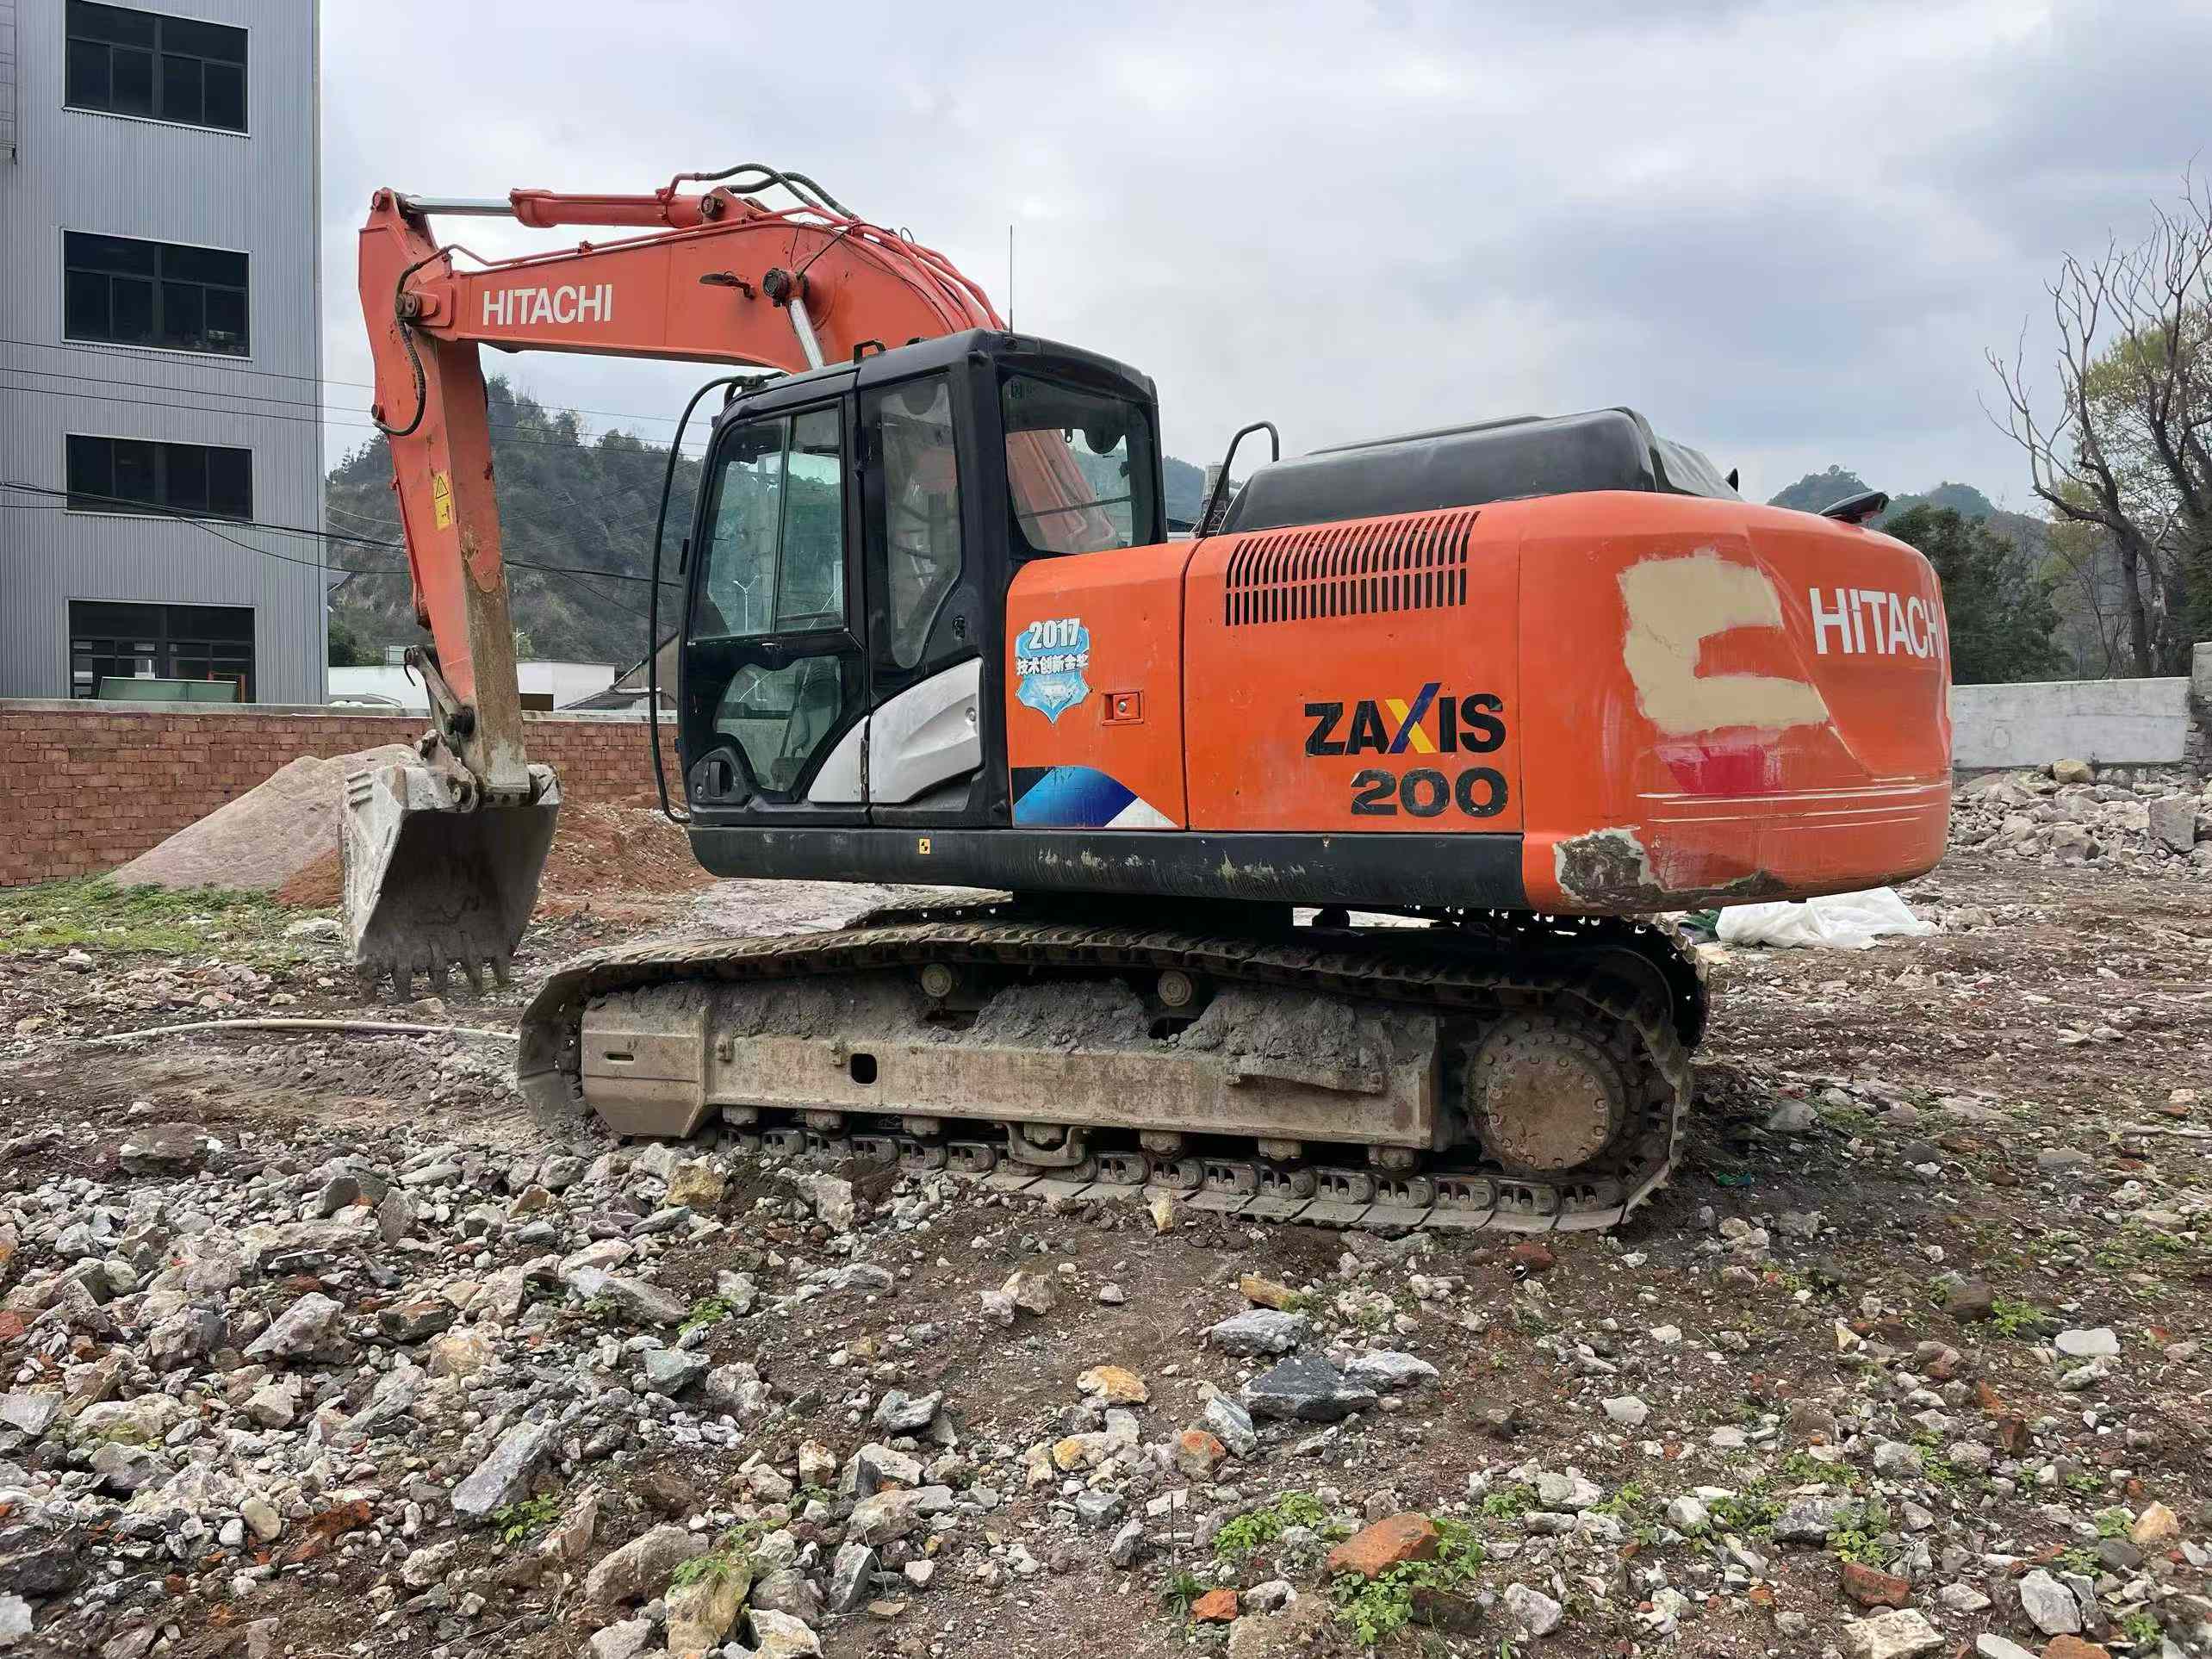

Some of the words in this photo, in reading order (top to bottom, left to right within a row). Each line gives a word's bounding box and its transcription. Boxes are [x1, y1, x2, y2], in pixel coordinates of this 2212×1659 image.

[482, 283, 613, 326] HITACHI
[1028, 618, 1080, 649] 2017
[1016, 653, 1090, 675] 技术创新金奖
[1304, 682, 1507, 756] ZAXIS
[1351, 767, 1508, 817] 200
